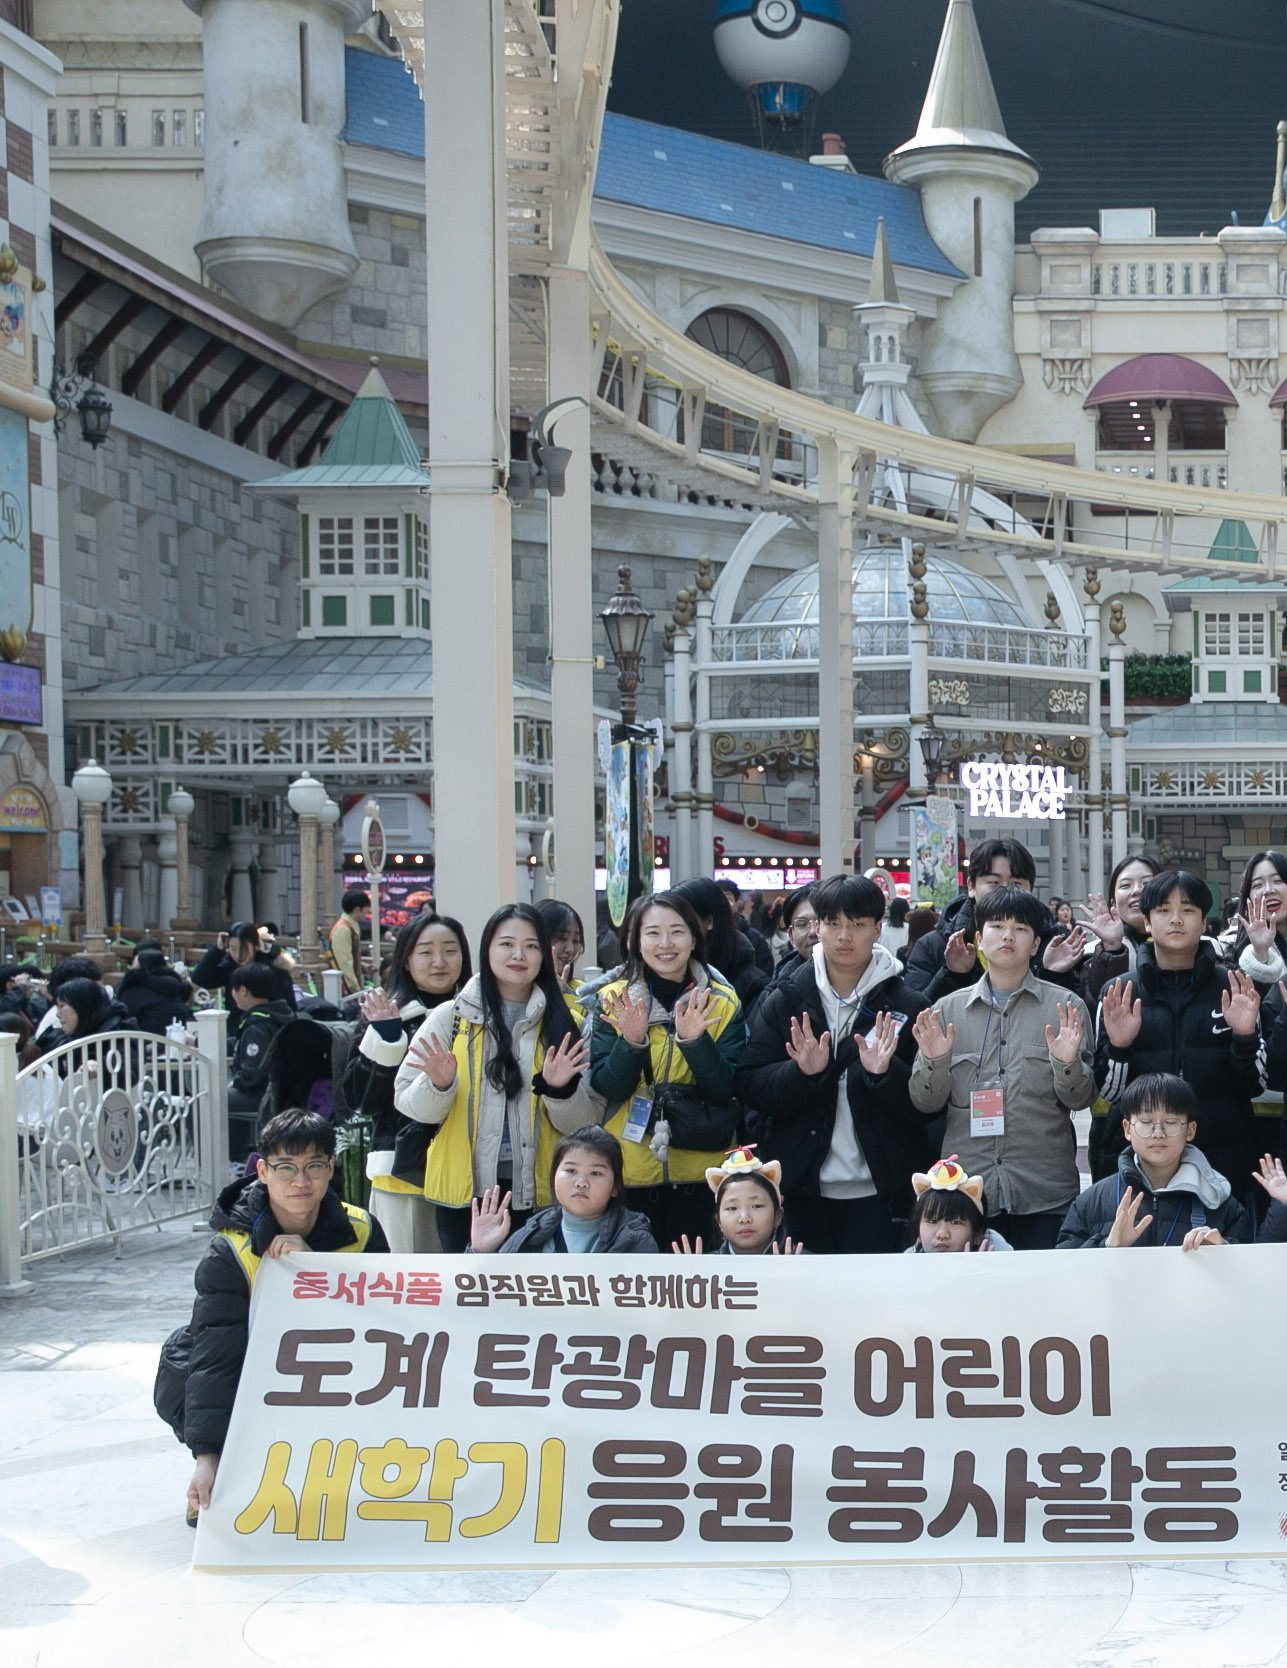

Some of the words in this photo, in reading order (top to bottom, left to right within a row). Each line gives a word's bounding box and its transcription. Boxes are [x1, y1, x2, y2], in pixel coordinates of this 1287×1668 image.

[961, 762, 1073, 794] CRYSTAL
[969, 788, 1066, 819] PALACE
[293, 1270, 443, 1307] 동서식품
[454, 1273, 601, 1308] 임직원과
[608, 1273, 759, 1311] 함께하는
[263, 1327, 450, 1409] 도계
[472, 1332, 827, 1418] 탄광마을
[853, 1333, 1112, 1420] 어린이
[234, 1436, 566, 1544] 새학기
[586, 1439, 795, 1543] 응원
[825, 1444, 1242, 1544] 봉사활동
